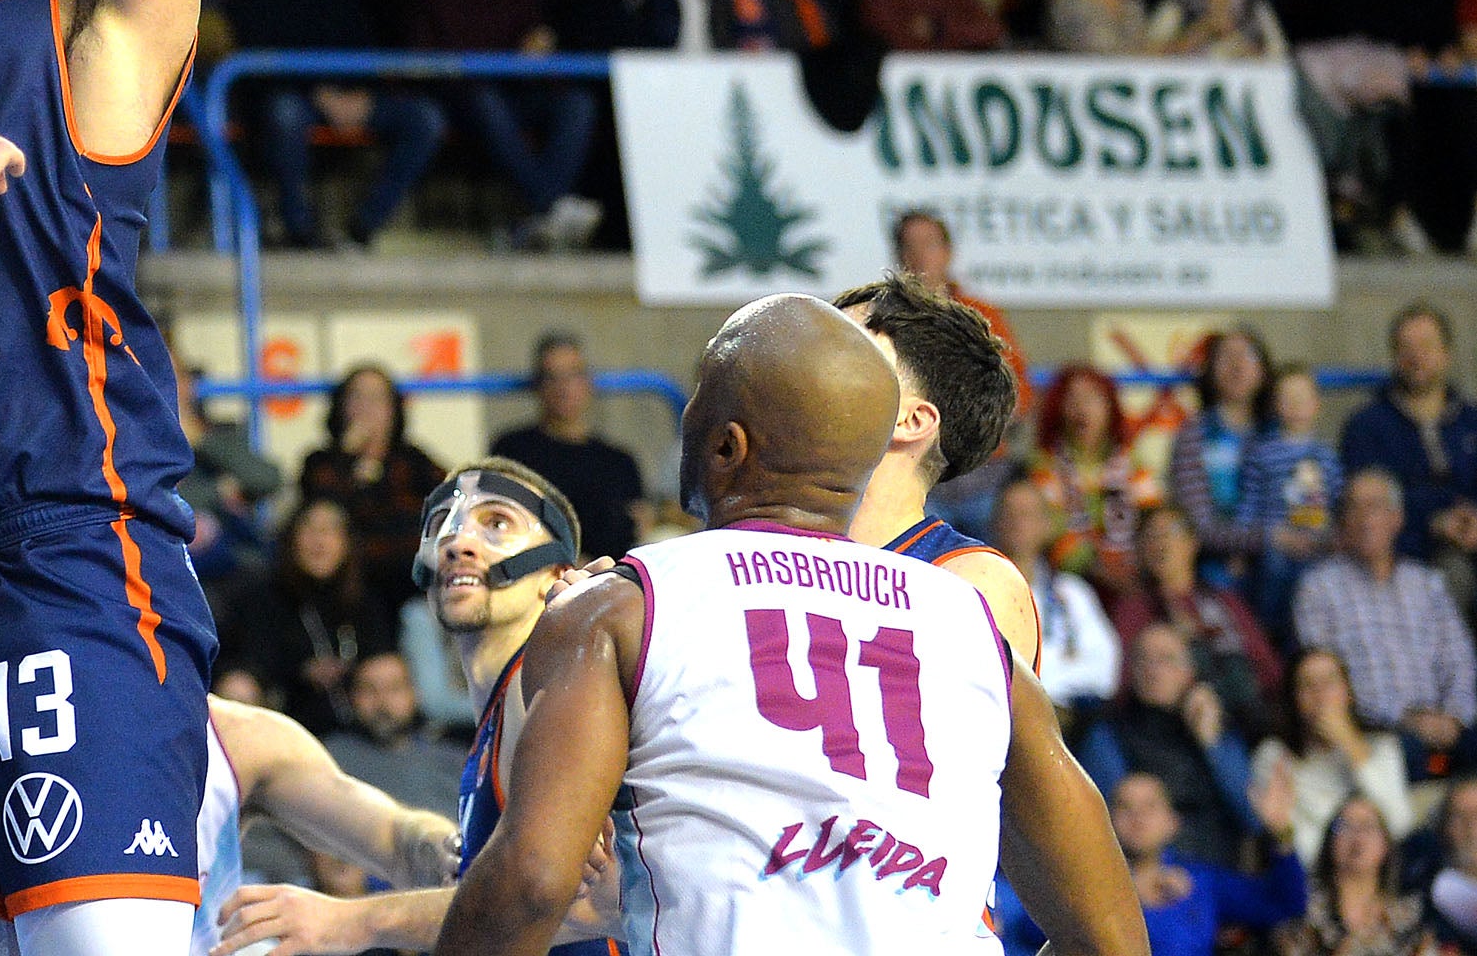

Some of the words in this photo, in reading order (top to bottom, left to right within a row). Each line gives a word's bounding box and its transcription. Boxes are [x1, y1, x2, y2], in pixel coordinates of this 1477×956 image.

[874, 78, 1272, 174] INDUSEN
[726, 551, 911, 610] HASBROUCK
[744, 608, 934, 800] 41
[760, 815, 948, 901] LLEIDA
